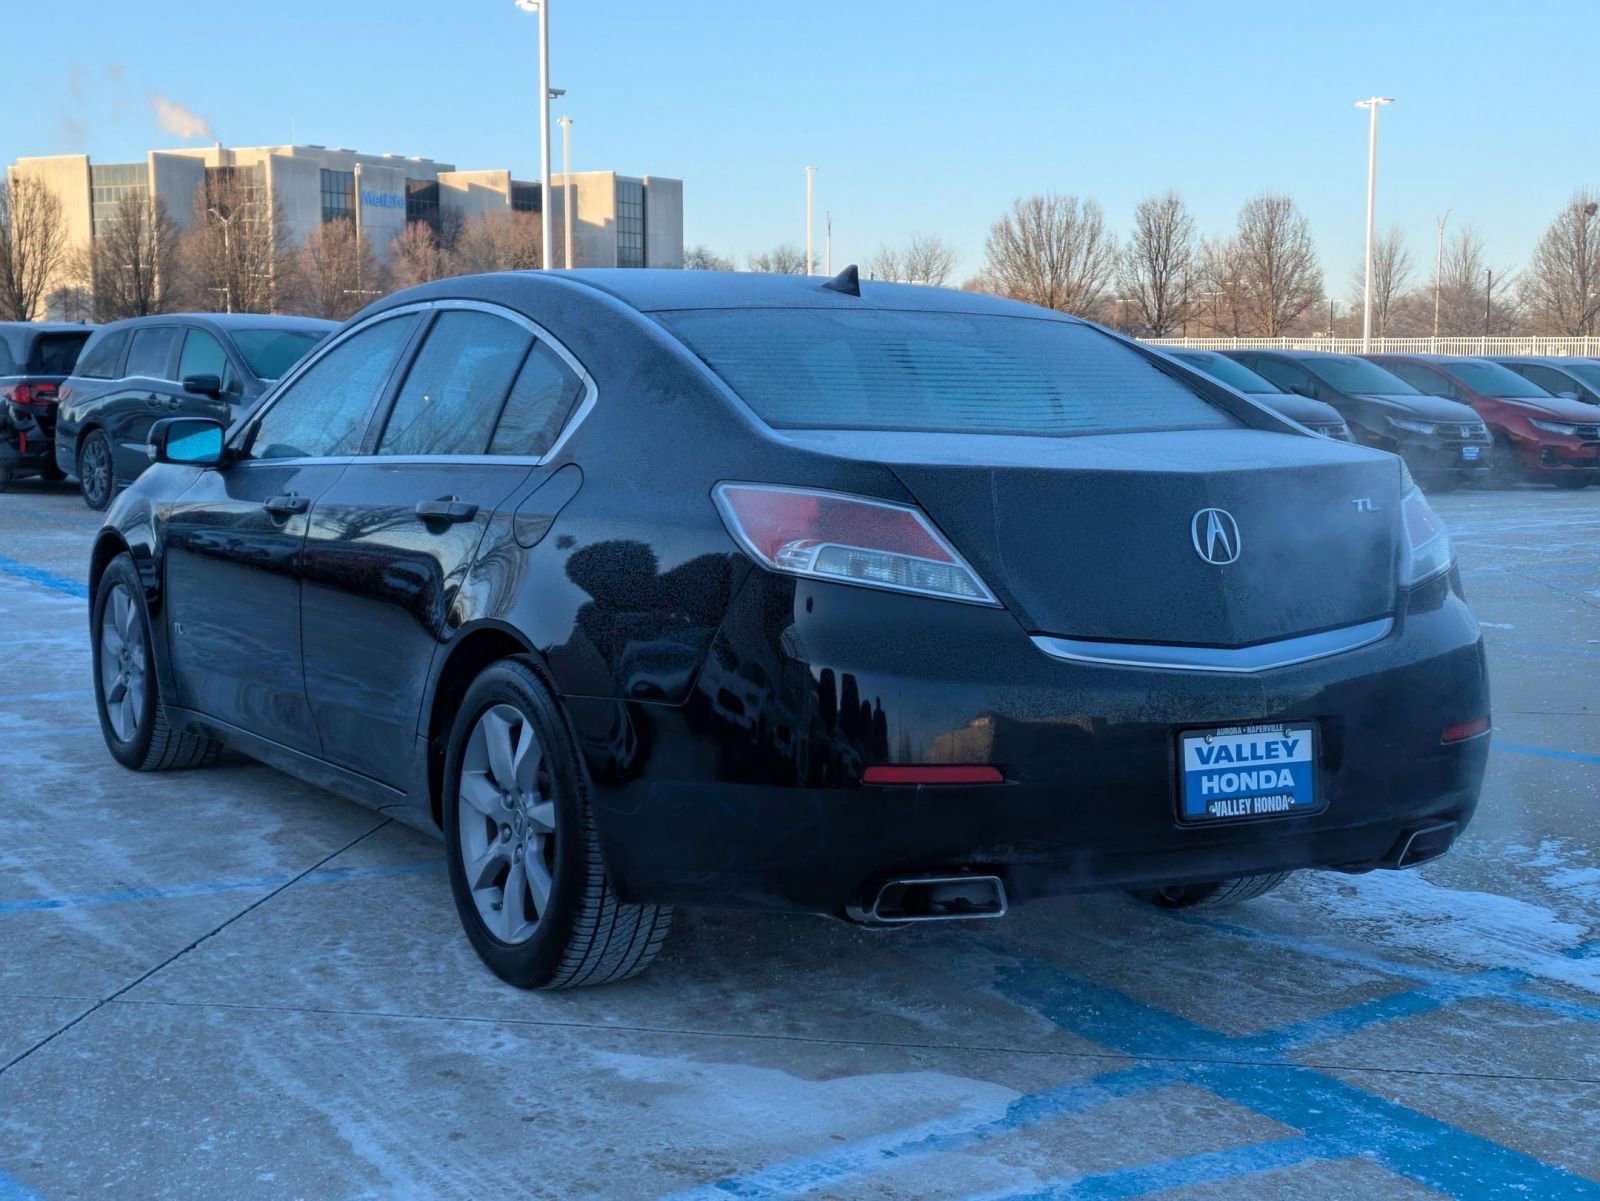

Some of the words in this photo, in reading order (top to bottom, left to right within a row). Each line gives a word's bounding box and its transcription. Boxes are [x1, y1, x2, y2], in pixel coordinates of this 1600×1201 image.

[362, 191, 405, 209] MetLife
[1352, 498, 1380, 513] TL
[1216, 726, 1242, 736] AURORA
[1246, 723, 1284, 734] NAPERVILLE
[1194, 739, 1300, 765] VALLEY
[1201, 768, 1295, 795] HONDA
[1214, 798, 1252, 817] VALLEY
[1254, 795, 1289, 814] HONDA
